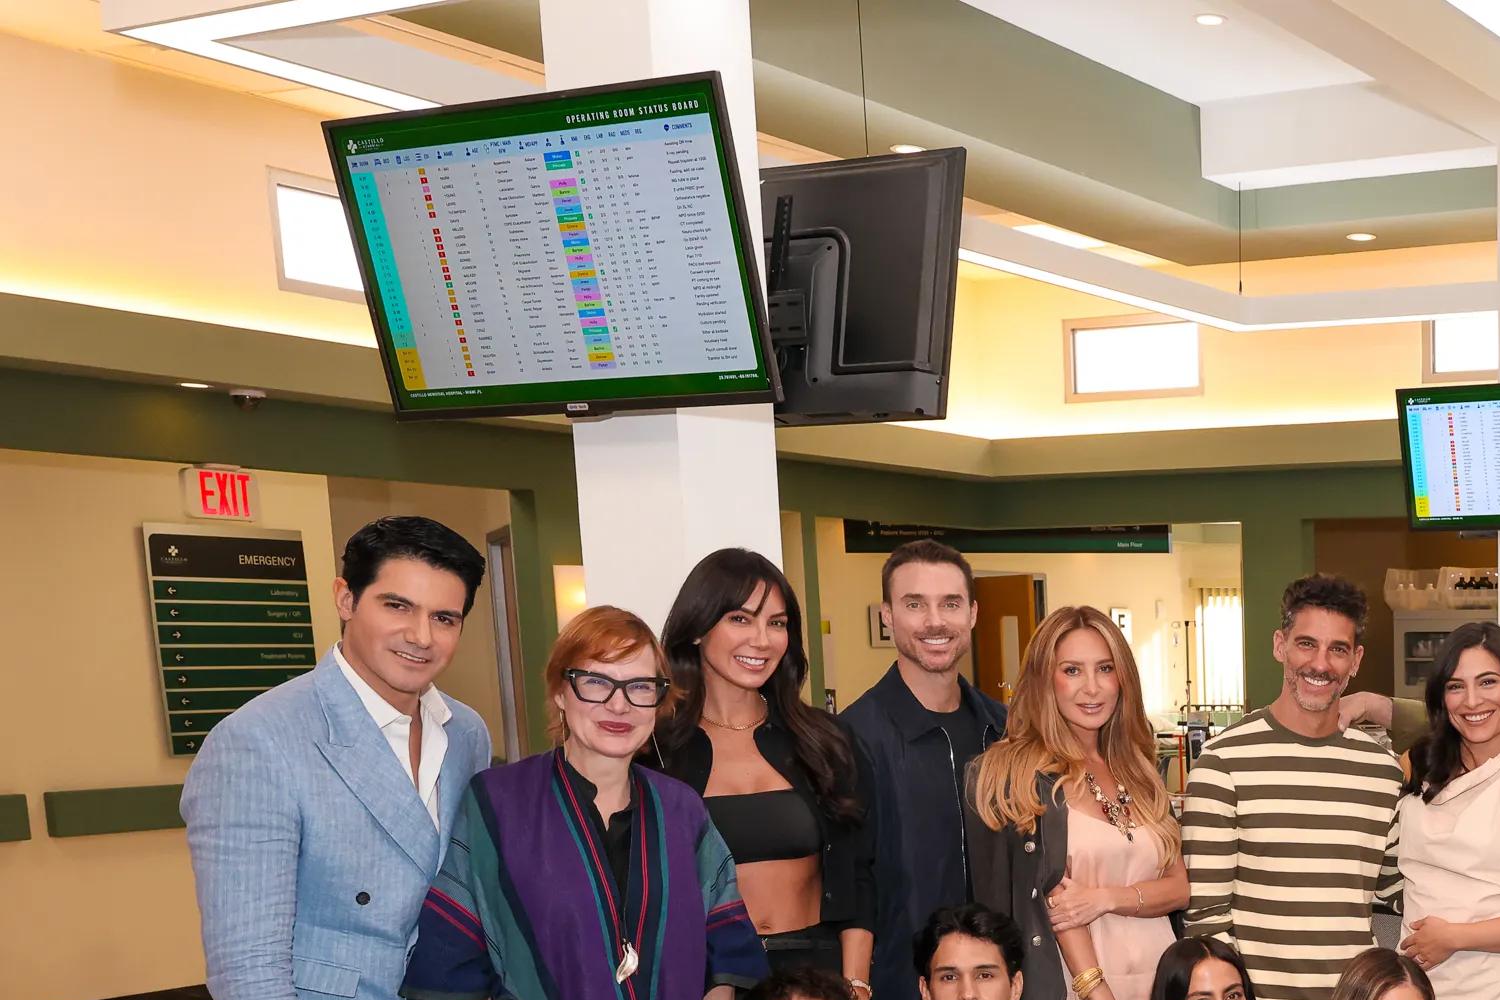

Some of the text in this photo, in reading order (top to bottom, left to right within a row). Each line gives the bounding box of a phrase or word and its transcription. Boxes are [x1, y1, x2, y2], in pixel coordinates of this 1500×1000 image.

[565, 99, 699, 124] OPERATING ROOM STATUS BOARD
[671, 122, 693, 130] COMMENTS
[356, 137, 385, 146] CASTILLO
[198, 470, 251, 517] EXIT
[238, 554, 297, 567] EMERGENCY
[270, 589, 299, 598] Laboratory
[266, 609, 288, 618] Surgery
[260, 652, 287, 660] Treatment
